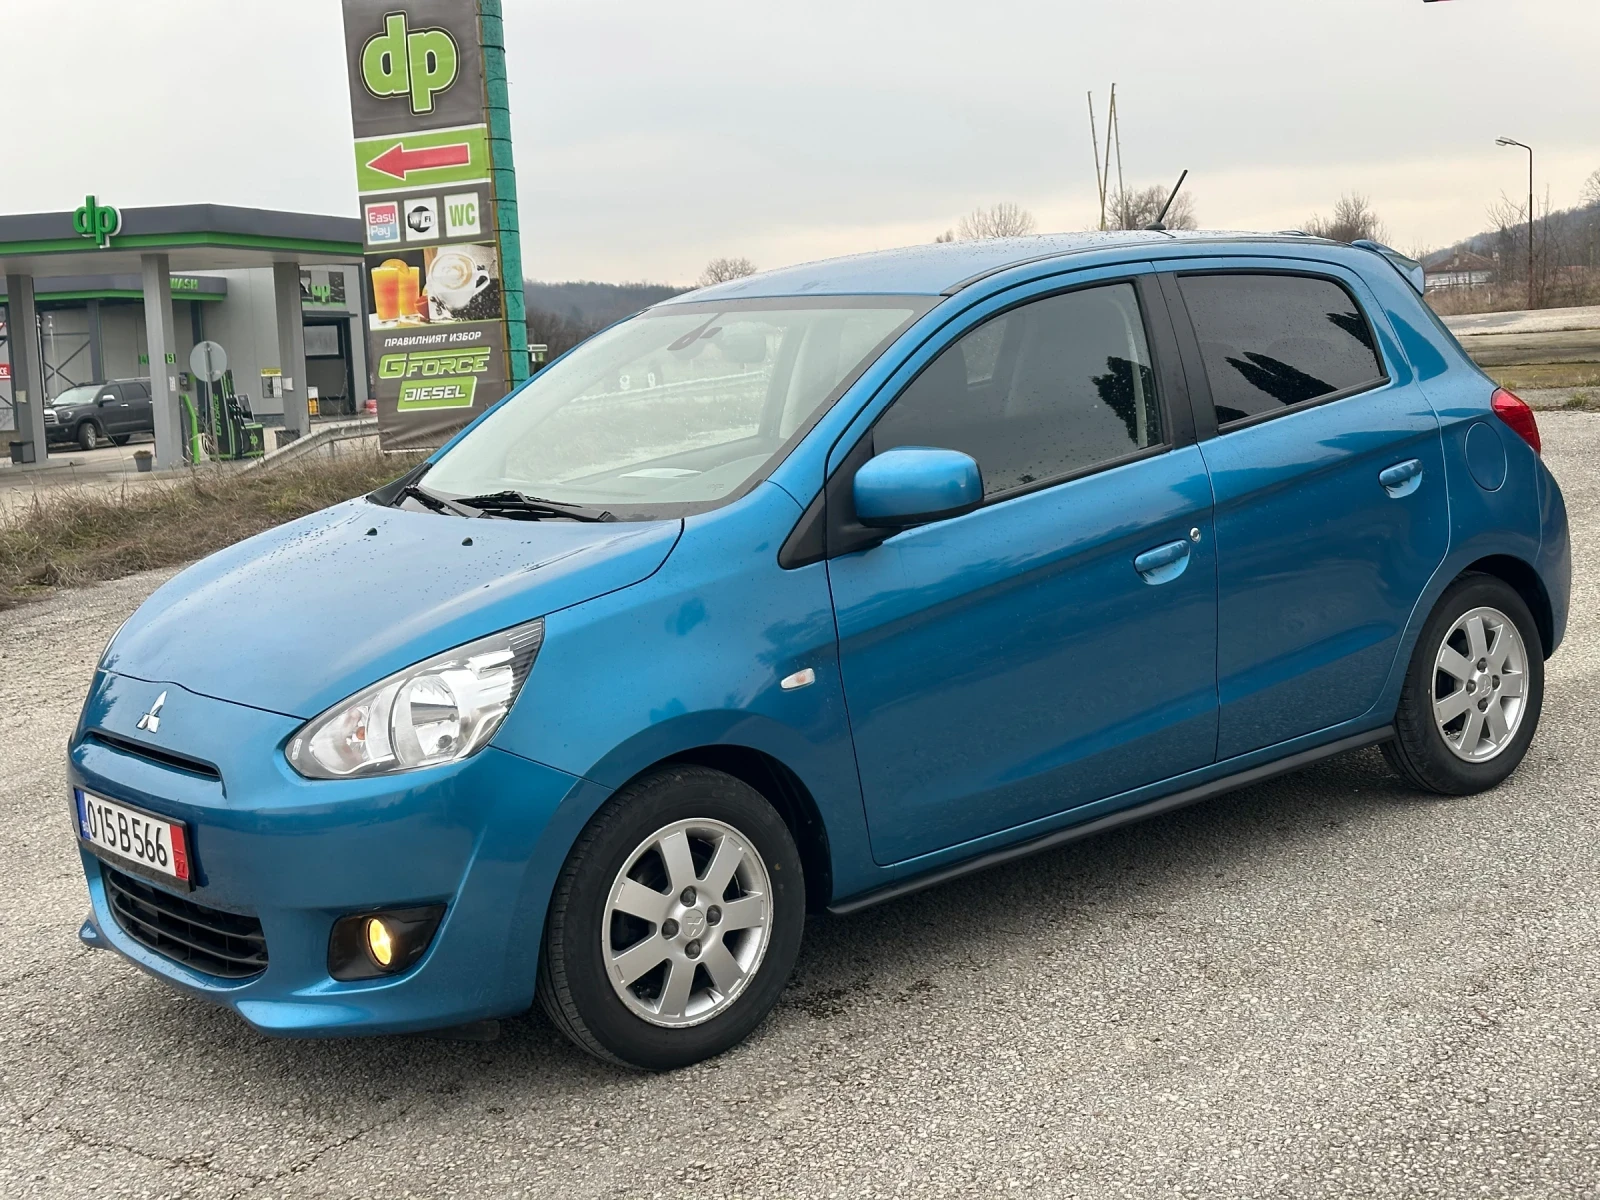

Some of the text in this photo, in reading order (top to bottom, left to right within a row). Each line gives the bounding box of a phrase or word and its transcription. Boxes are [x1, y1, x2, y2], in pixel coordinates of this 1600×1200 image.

[361, 12, 458, 114] dp
[73, 195, 120, 246] dp
[369, 212, 395, 225] Easy
[450, 203, 475, 227] WC
[370, 225, 391, 238] Pay
[384, 331, 482, 347] ПРАВИЛНИЯТ ИЗБОР
[404, 385, 466, 402] DIESEL
